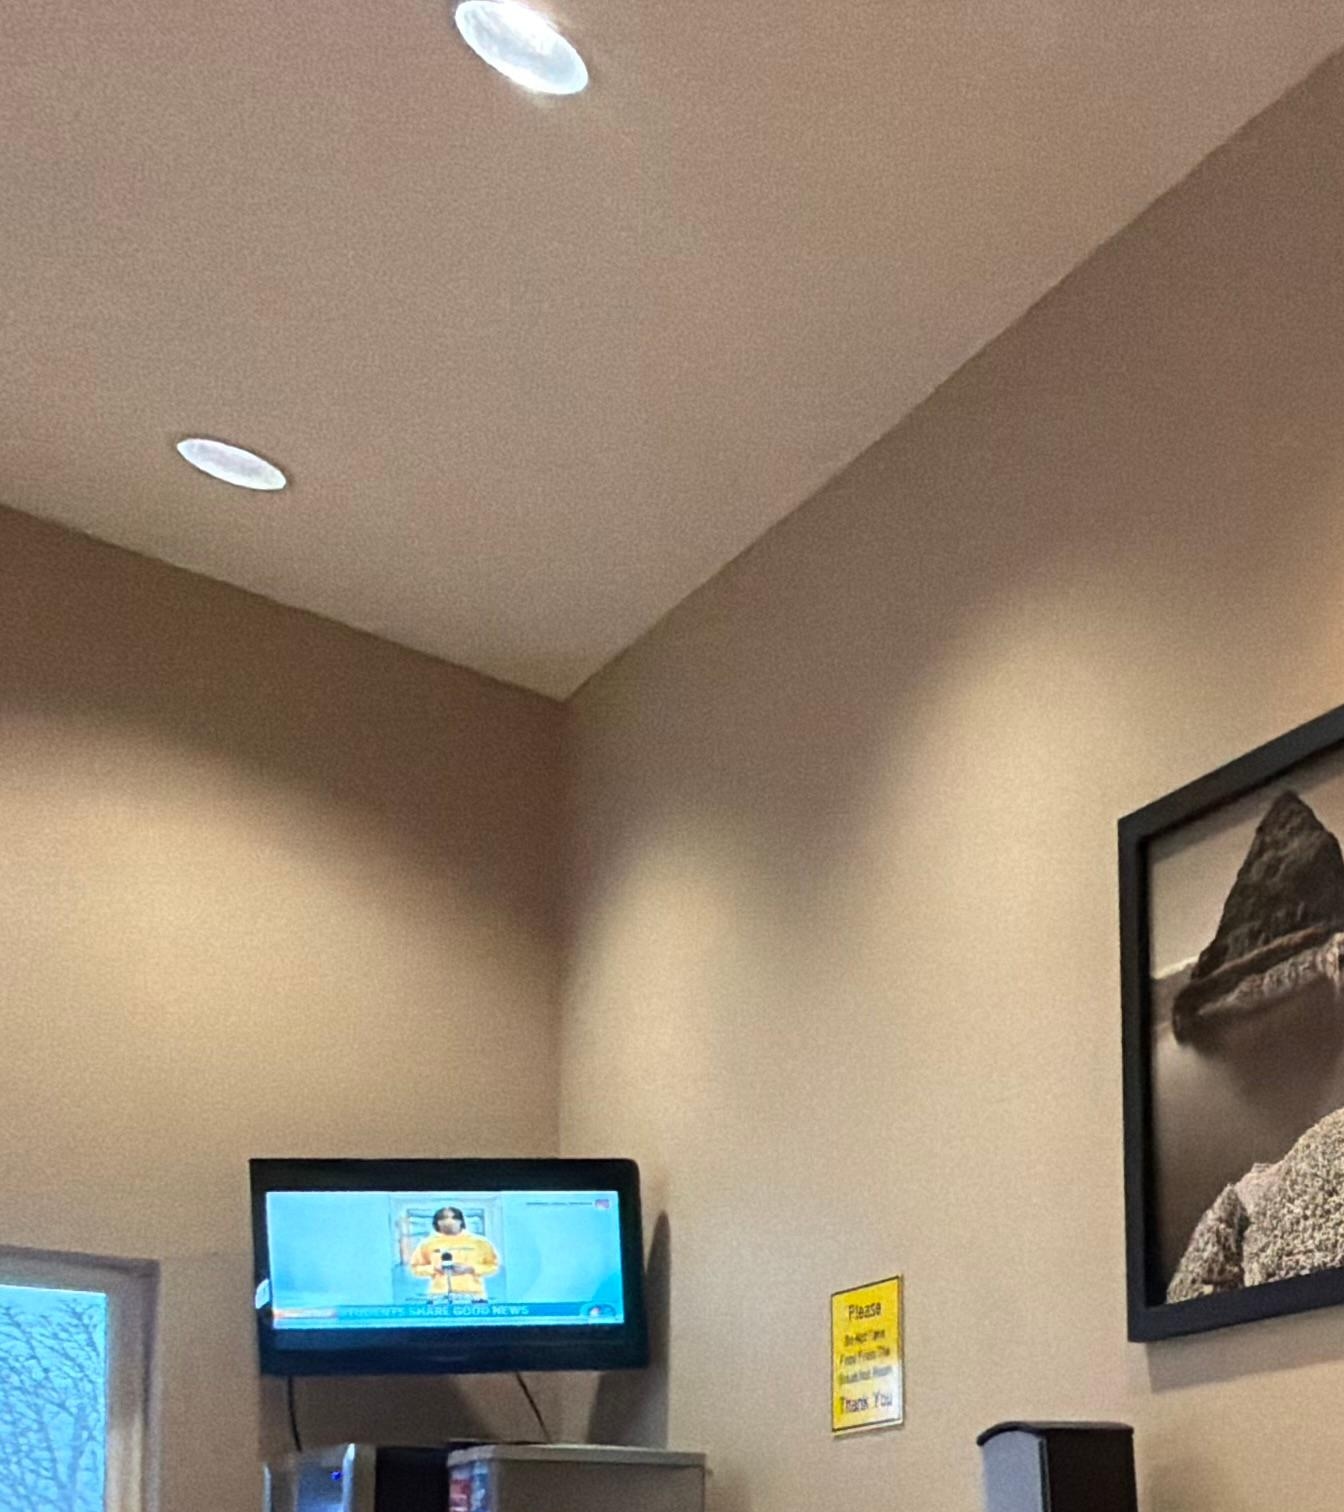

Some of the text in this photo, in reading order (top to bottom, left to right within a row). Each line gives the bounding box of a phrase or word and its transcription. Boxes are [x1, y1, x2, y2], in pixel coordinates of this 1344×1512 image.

[453, 1305, 488, 1316] GOOD
[492, 1304, 529, 1316] NEWS
[848, 1302, 881, 1321] Please
